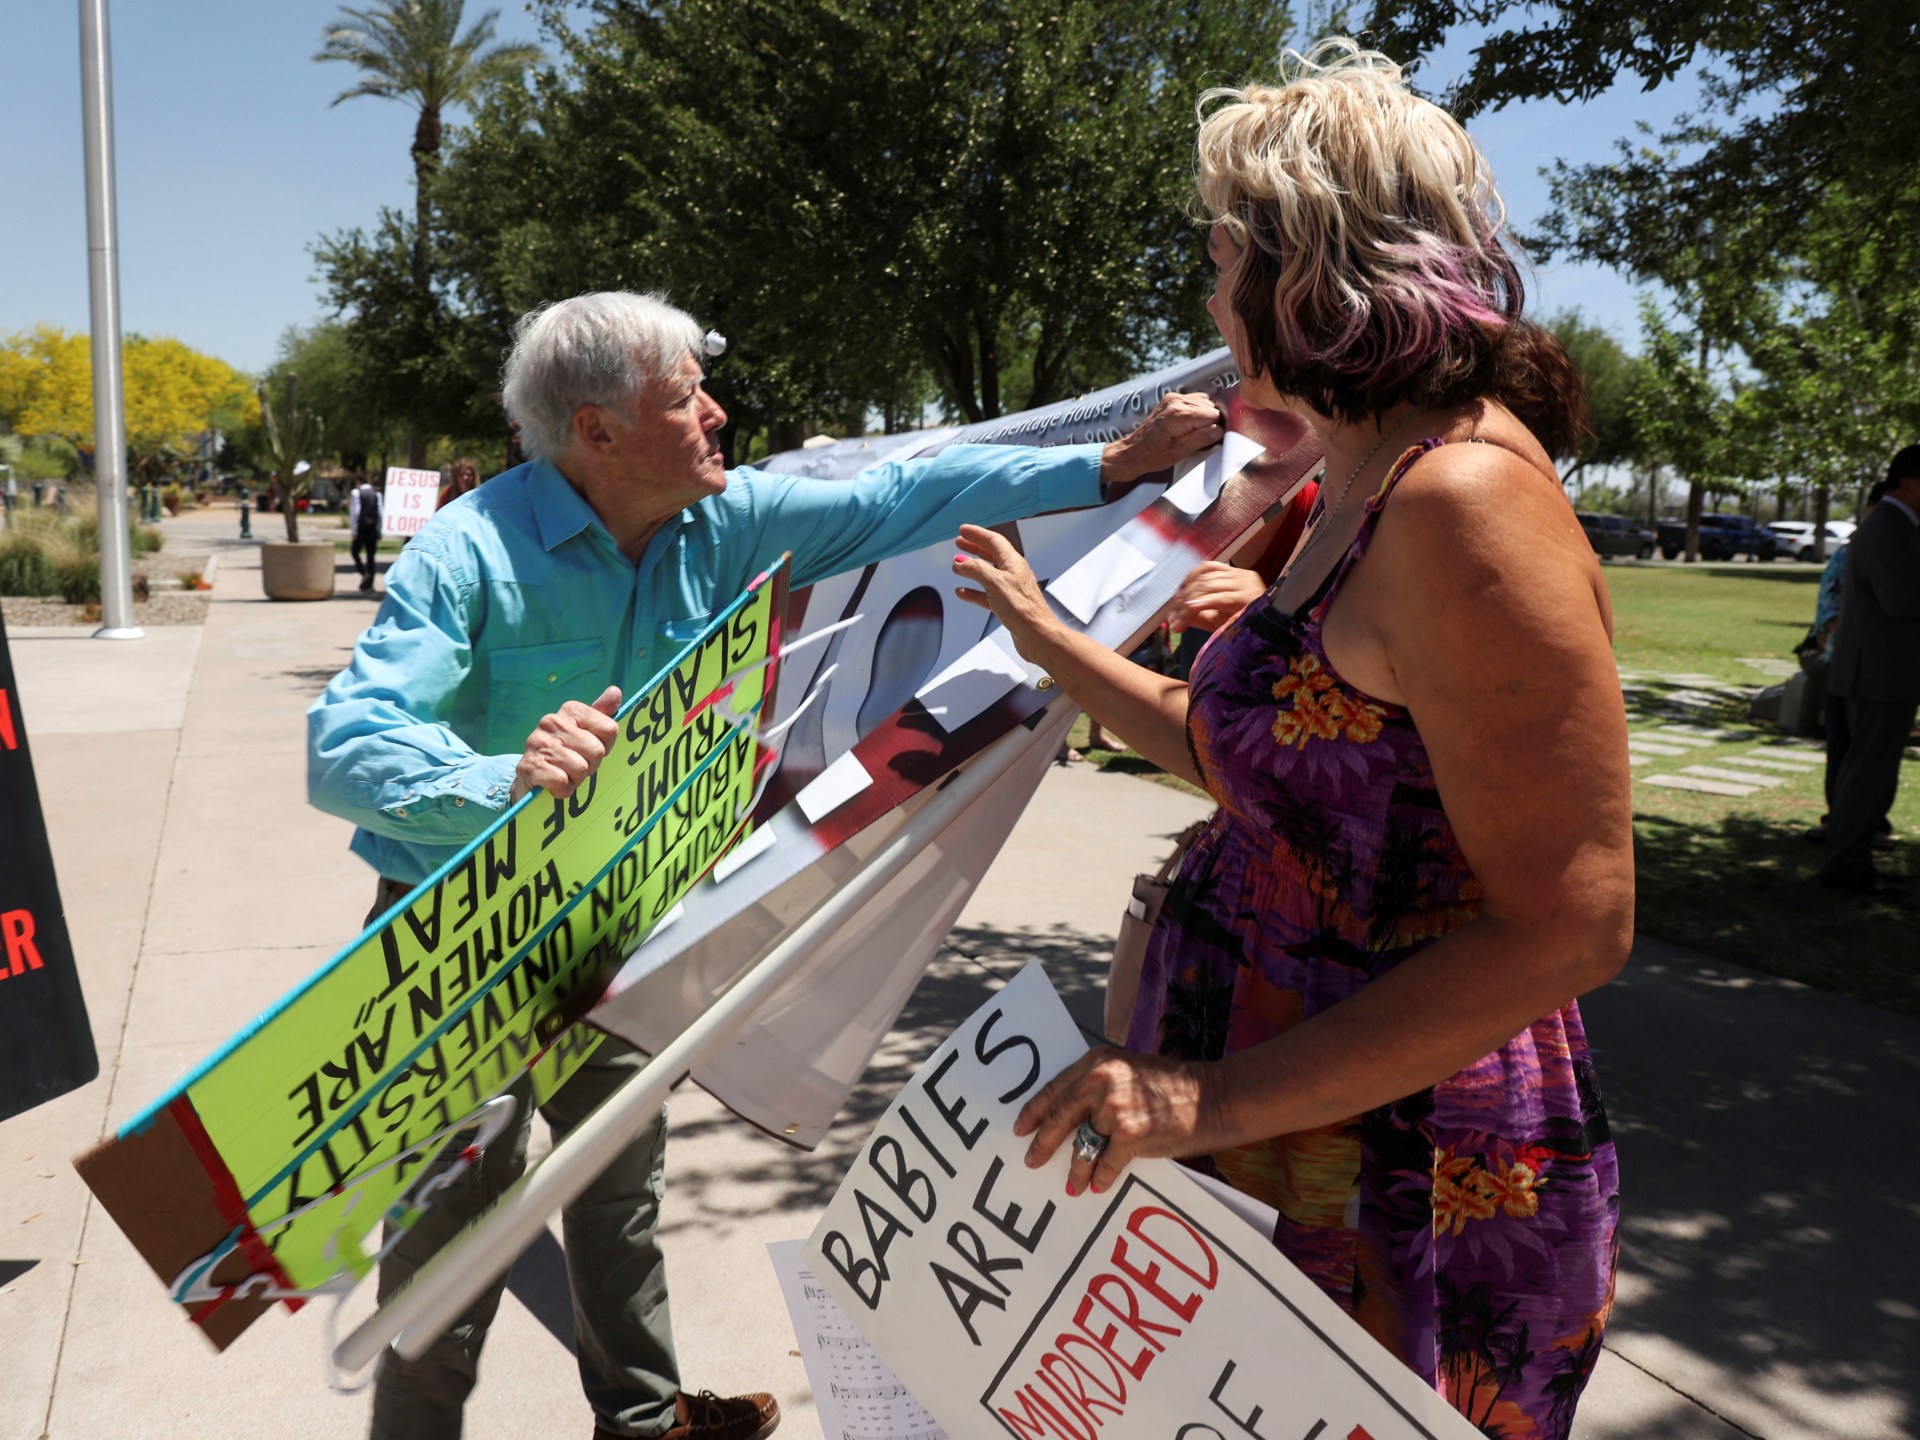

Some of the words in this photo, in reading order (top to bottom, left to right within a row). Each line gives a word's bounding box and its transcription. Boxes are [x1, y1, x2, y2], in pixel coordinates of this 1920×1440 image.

[387, 470, 439, 488] JESUS
[403, 493, 422, 509] IS
[997, 411, 1062, 438] Heritage
[1062, 397, 1113, 424] House
[625, 594, 760, 766] SLABS
[541, 769, 598, 852] OF
[590, 730, 751, 934] ABORTION
[614, 702, 738, 838] TRUMP:
[653, 785, 751, 918] TRUMP
[353, 815, 517, 1029] MEAT"
[408, 858, 586, 1038] "WOMEN
[288, 1002, 397, 1148] ARE
[393, 1002, 539, 1186] ALLEY
[821, 1008, 1041, 1311] BABIES
[929, 1154, 1057, 1347] ARE
[998, 1205, 1219, 1440] MURDERED
